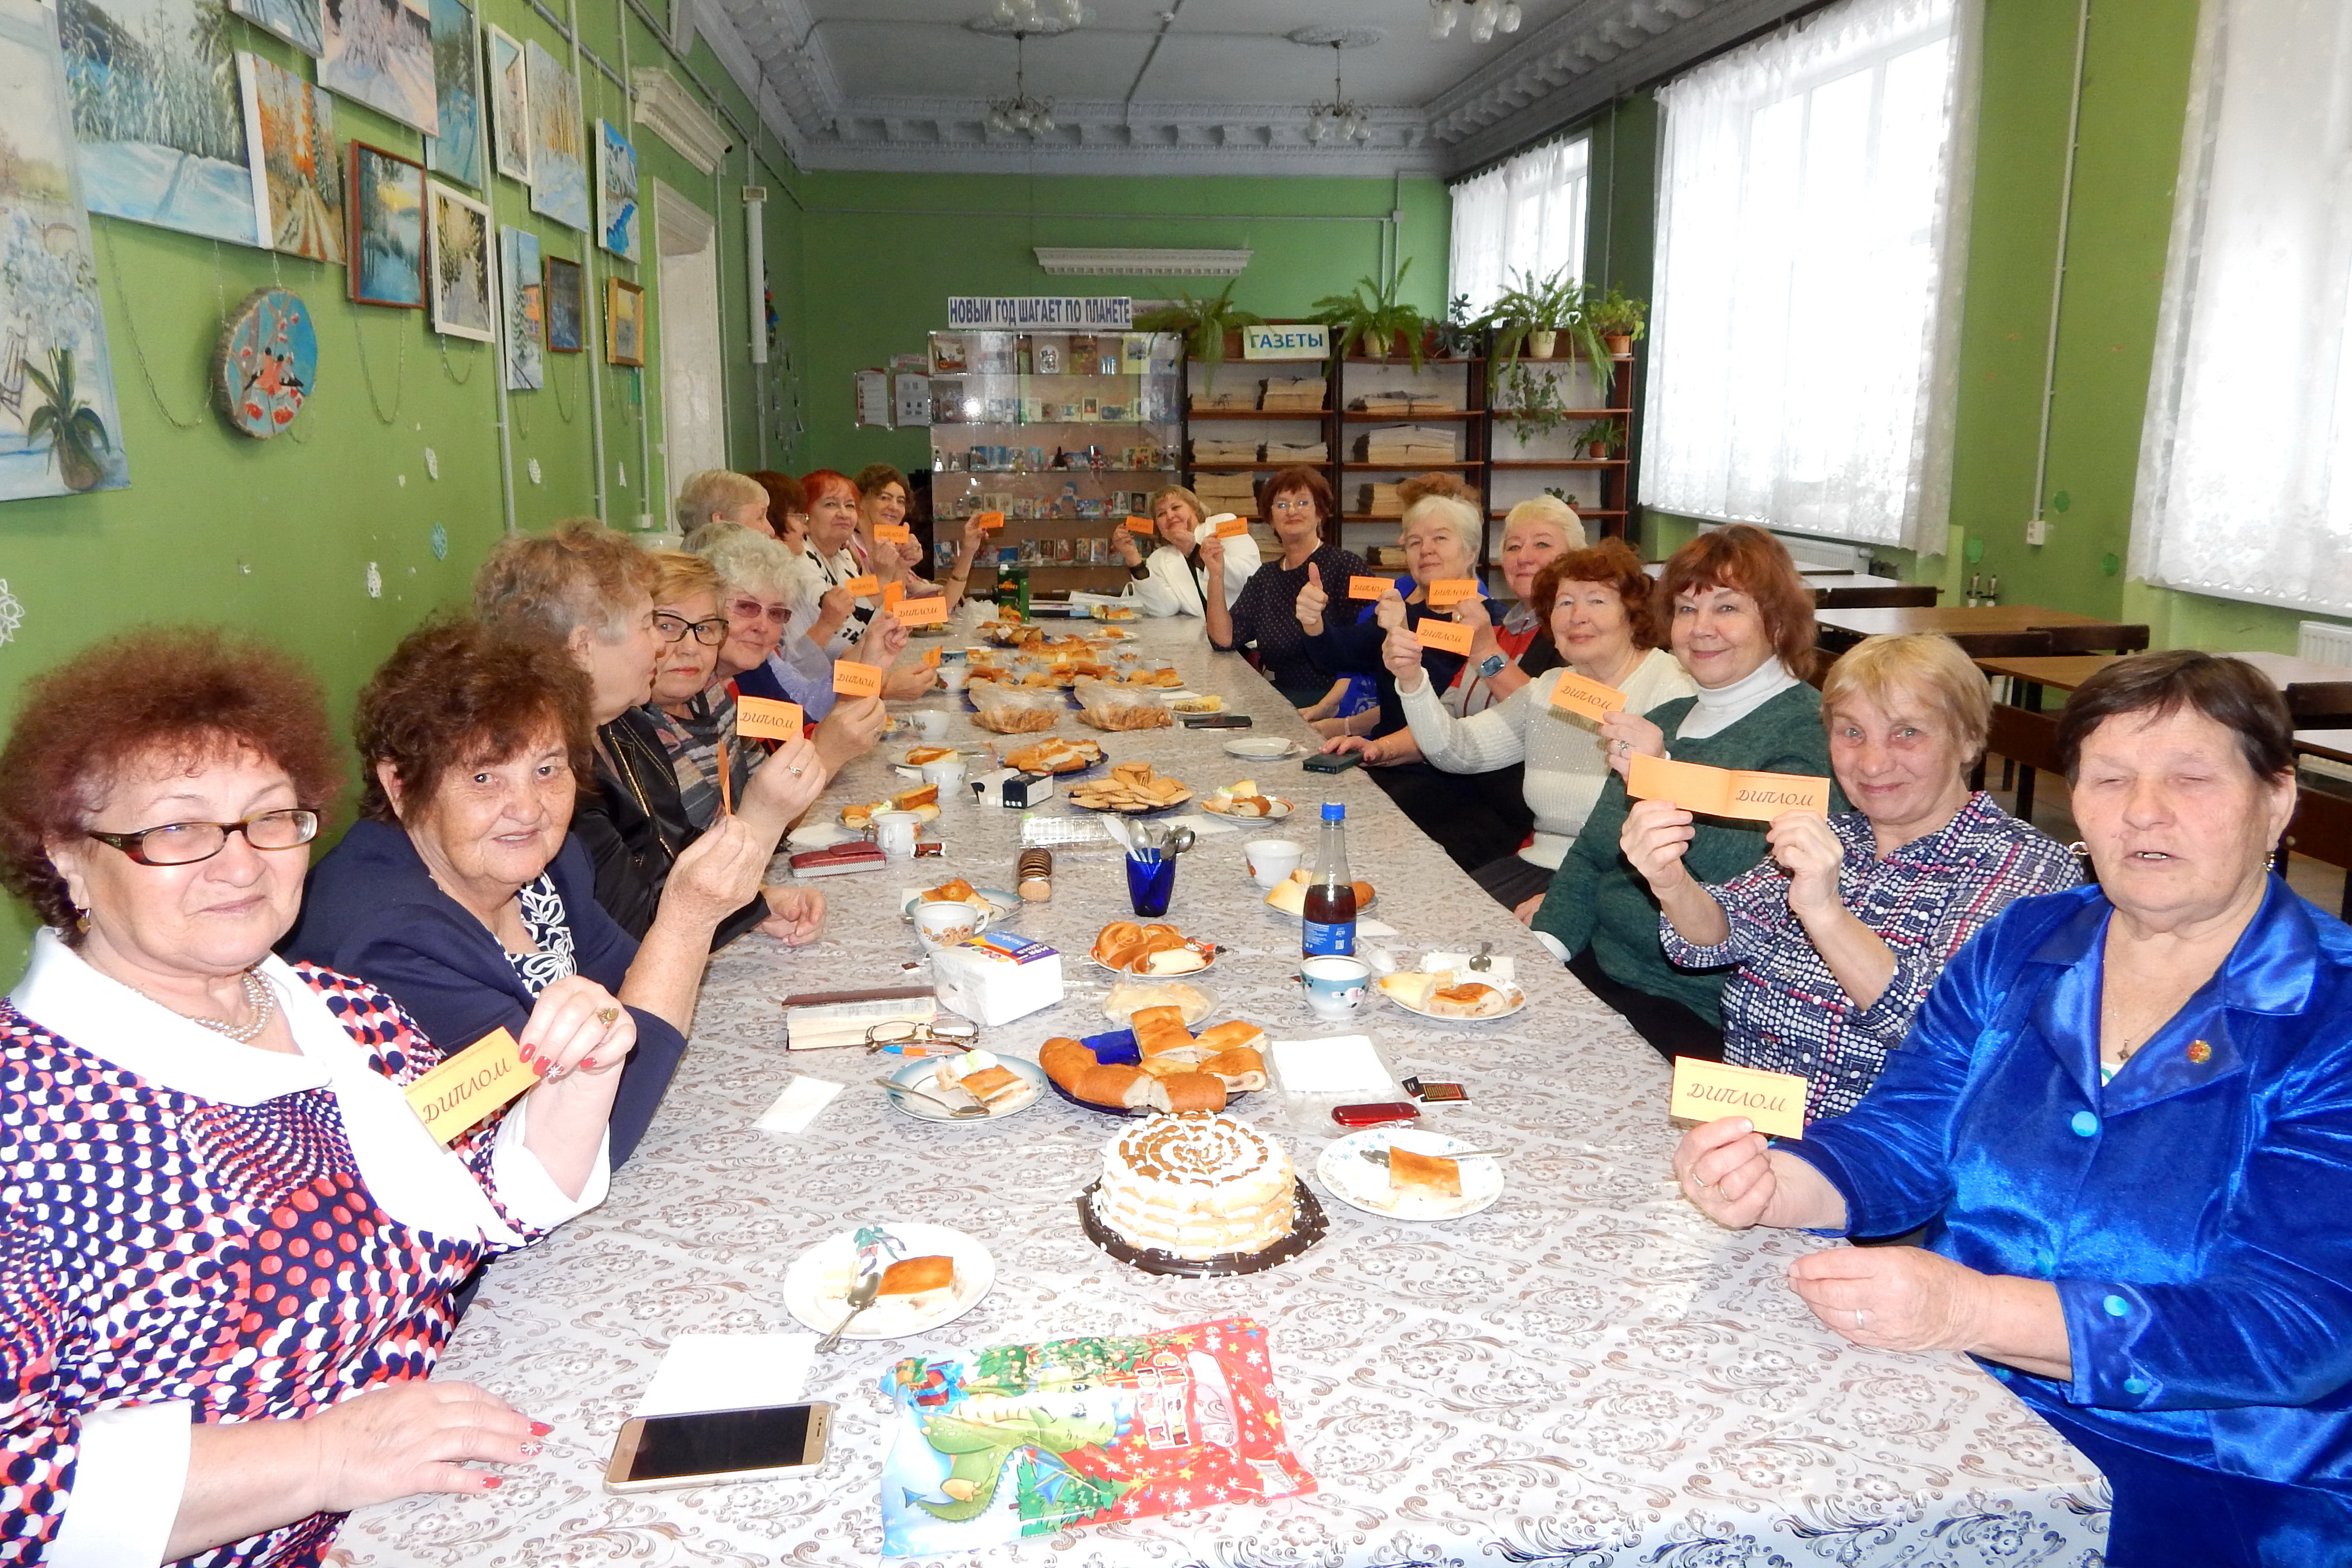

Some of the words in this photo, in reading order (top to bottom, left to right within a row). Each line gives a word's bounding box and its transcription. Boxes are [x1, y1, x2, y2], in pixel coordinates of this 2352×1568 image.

[995, 299, 1016, 326] ГОД
[1019, 299, 1062, 323] ШАГАЕТ
[1065, 299, 1082, 323] ПО
[1086, 298, 1131, 323] ПЛАНЕТЕ
[1250, 333, 1323, 349] ГАЗЕТЫ
[898, 607, 938, 618] ДИПЛОМ
[1423, 628, 1463, 643] ДИПЛОМ
[836, 673, 875, 688] ДИПЛОМ
[1561, 685, 1613, 710] ДИПЛОМ
[739, 712, 795, 729] ДИПЛОМ
[1735, 789, 1815, 807] ДИПЛОМ
[423, 1058, 513, 1125] ДИПЛОМ
[1687, 1083, 1788, 1112] ДИПЛОМ
